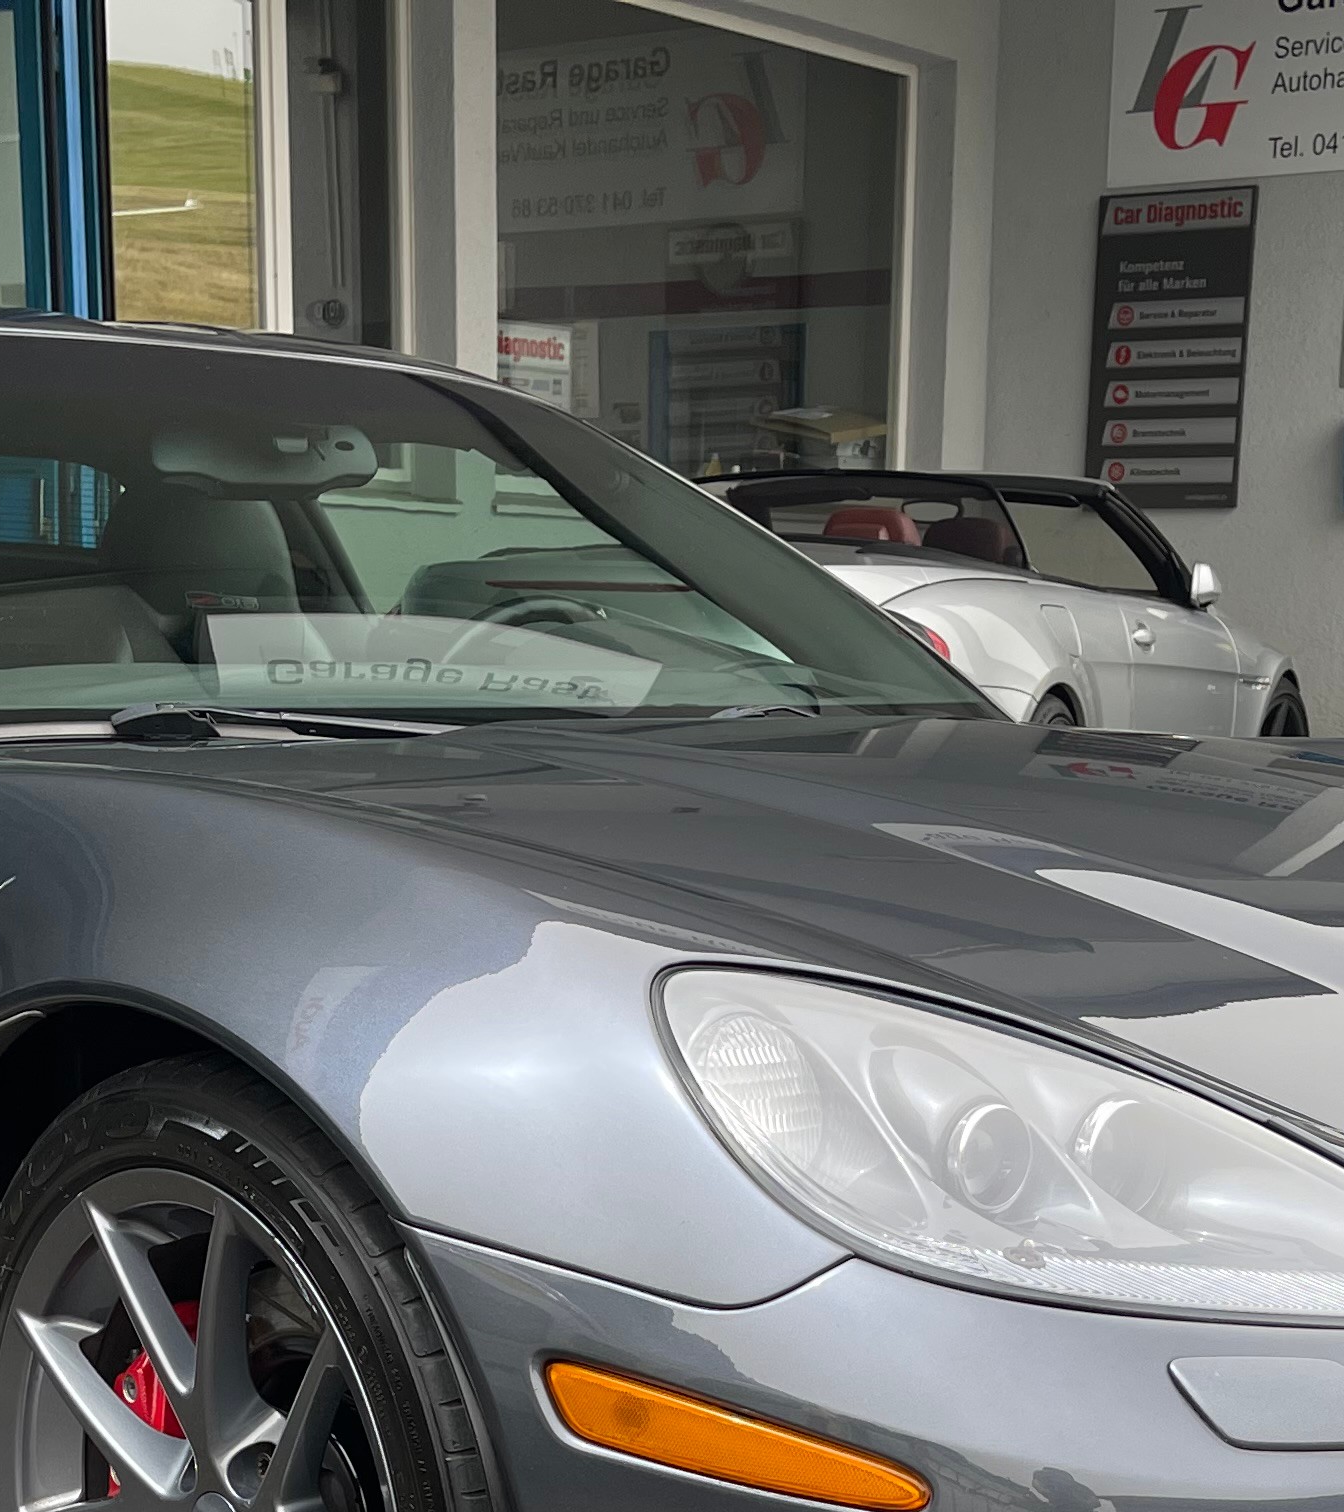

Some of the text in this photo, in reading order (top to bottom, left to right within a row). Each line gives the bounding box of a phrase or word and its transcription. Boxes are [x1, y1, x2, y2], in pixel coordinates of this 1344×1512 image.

[1268, 135, 1304, 159] Tel.
[1113, 197, 1244, 228] Car Diagnostic
[1119, 260, 1185, 275] Kompetenz
[1118, 277, 1207, 292] für alle Marken
